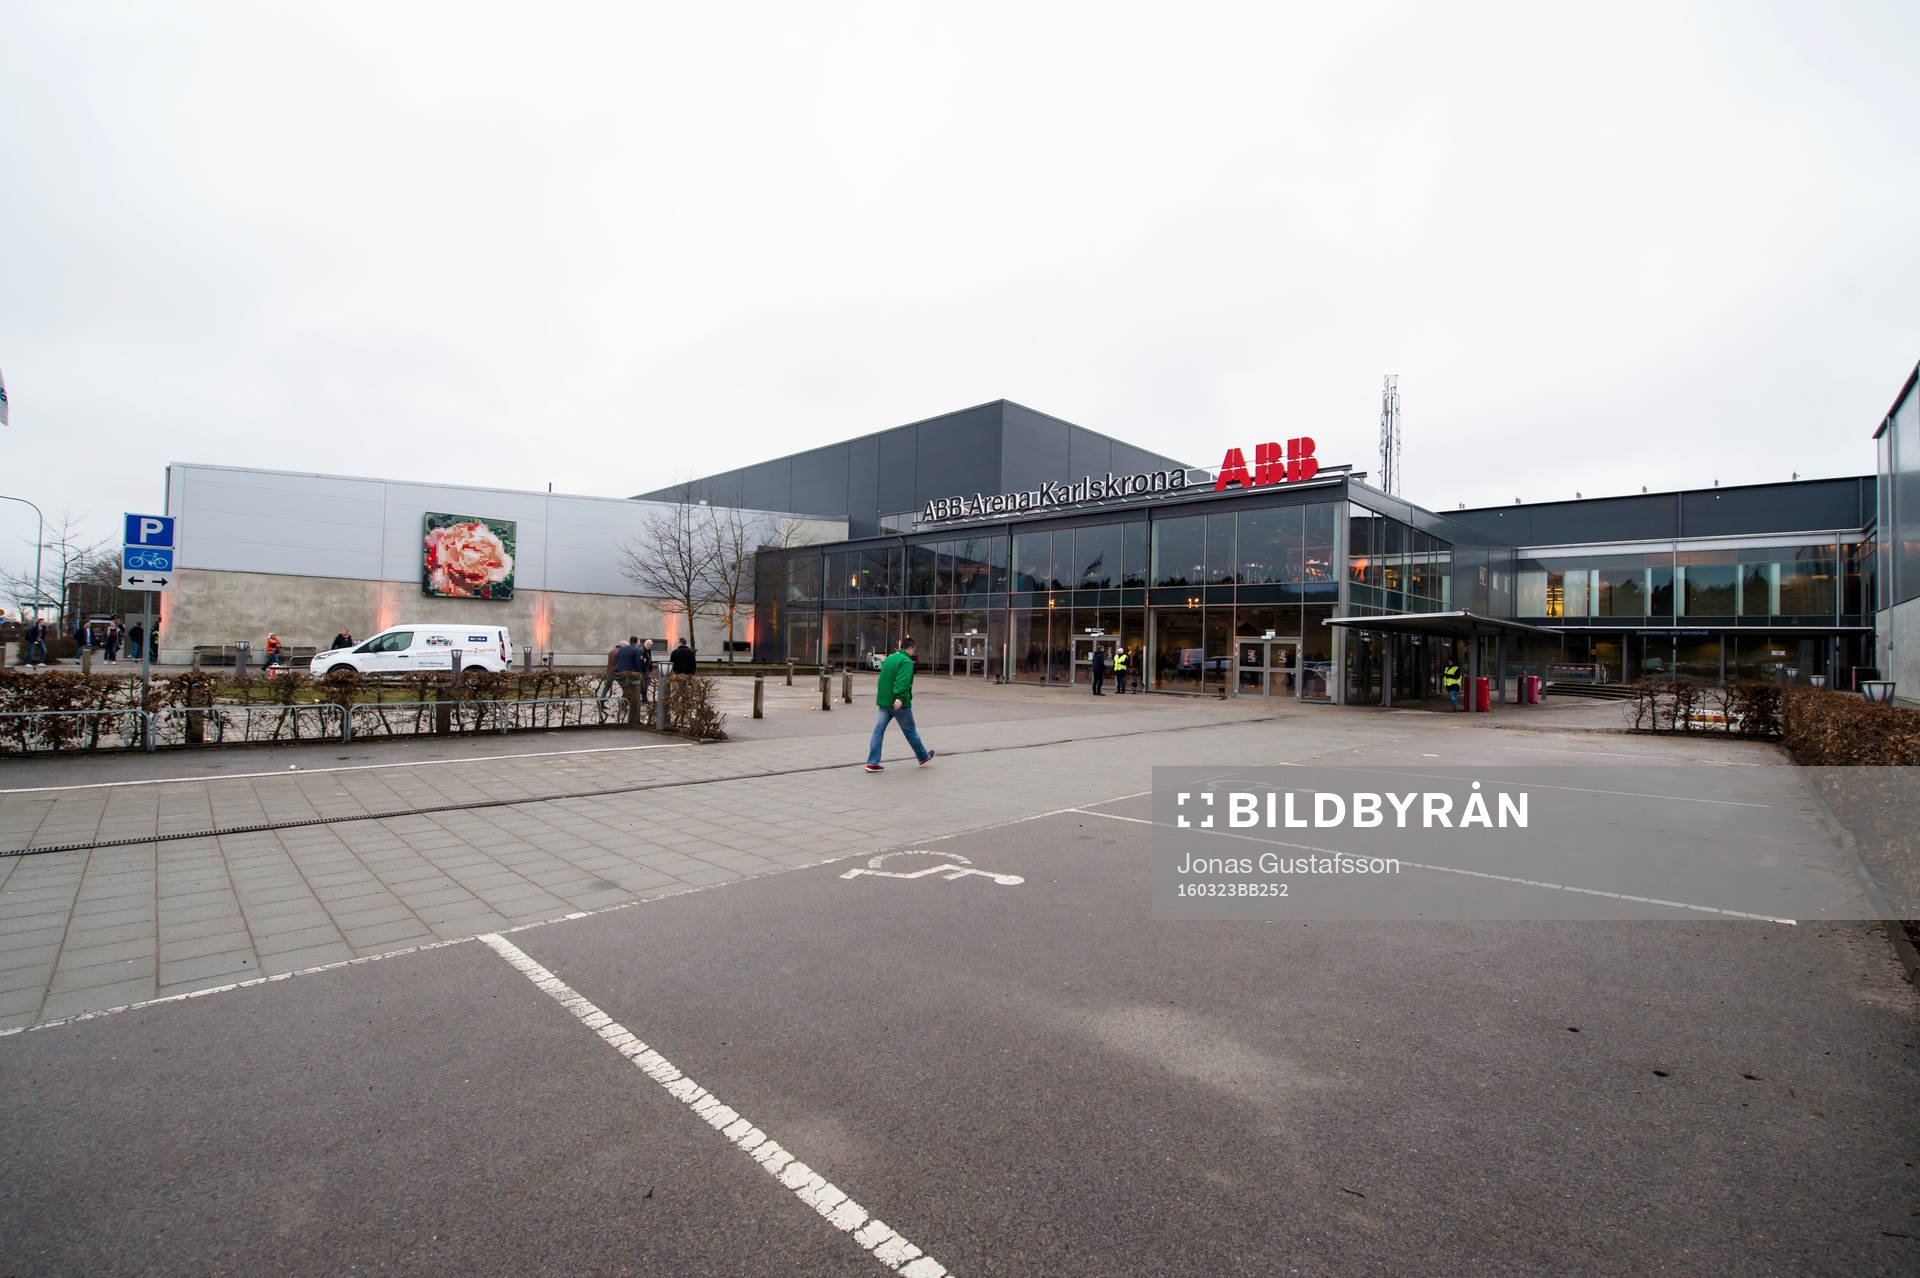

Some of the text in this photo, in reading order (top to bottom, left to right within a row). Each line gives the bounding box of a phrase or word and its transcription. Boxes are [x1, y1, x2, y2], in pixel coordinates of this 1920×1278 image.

[1214, 437, 1319, 491] ABB
[922, 467, 1188, 522] ABB Arena Karlskrona
[140, 518, 164, 543] P
